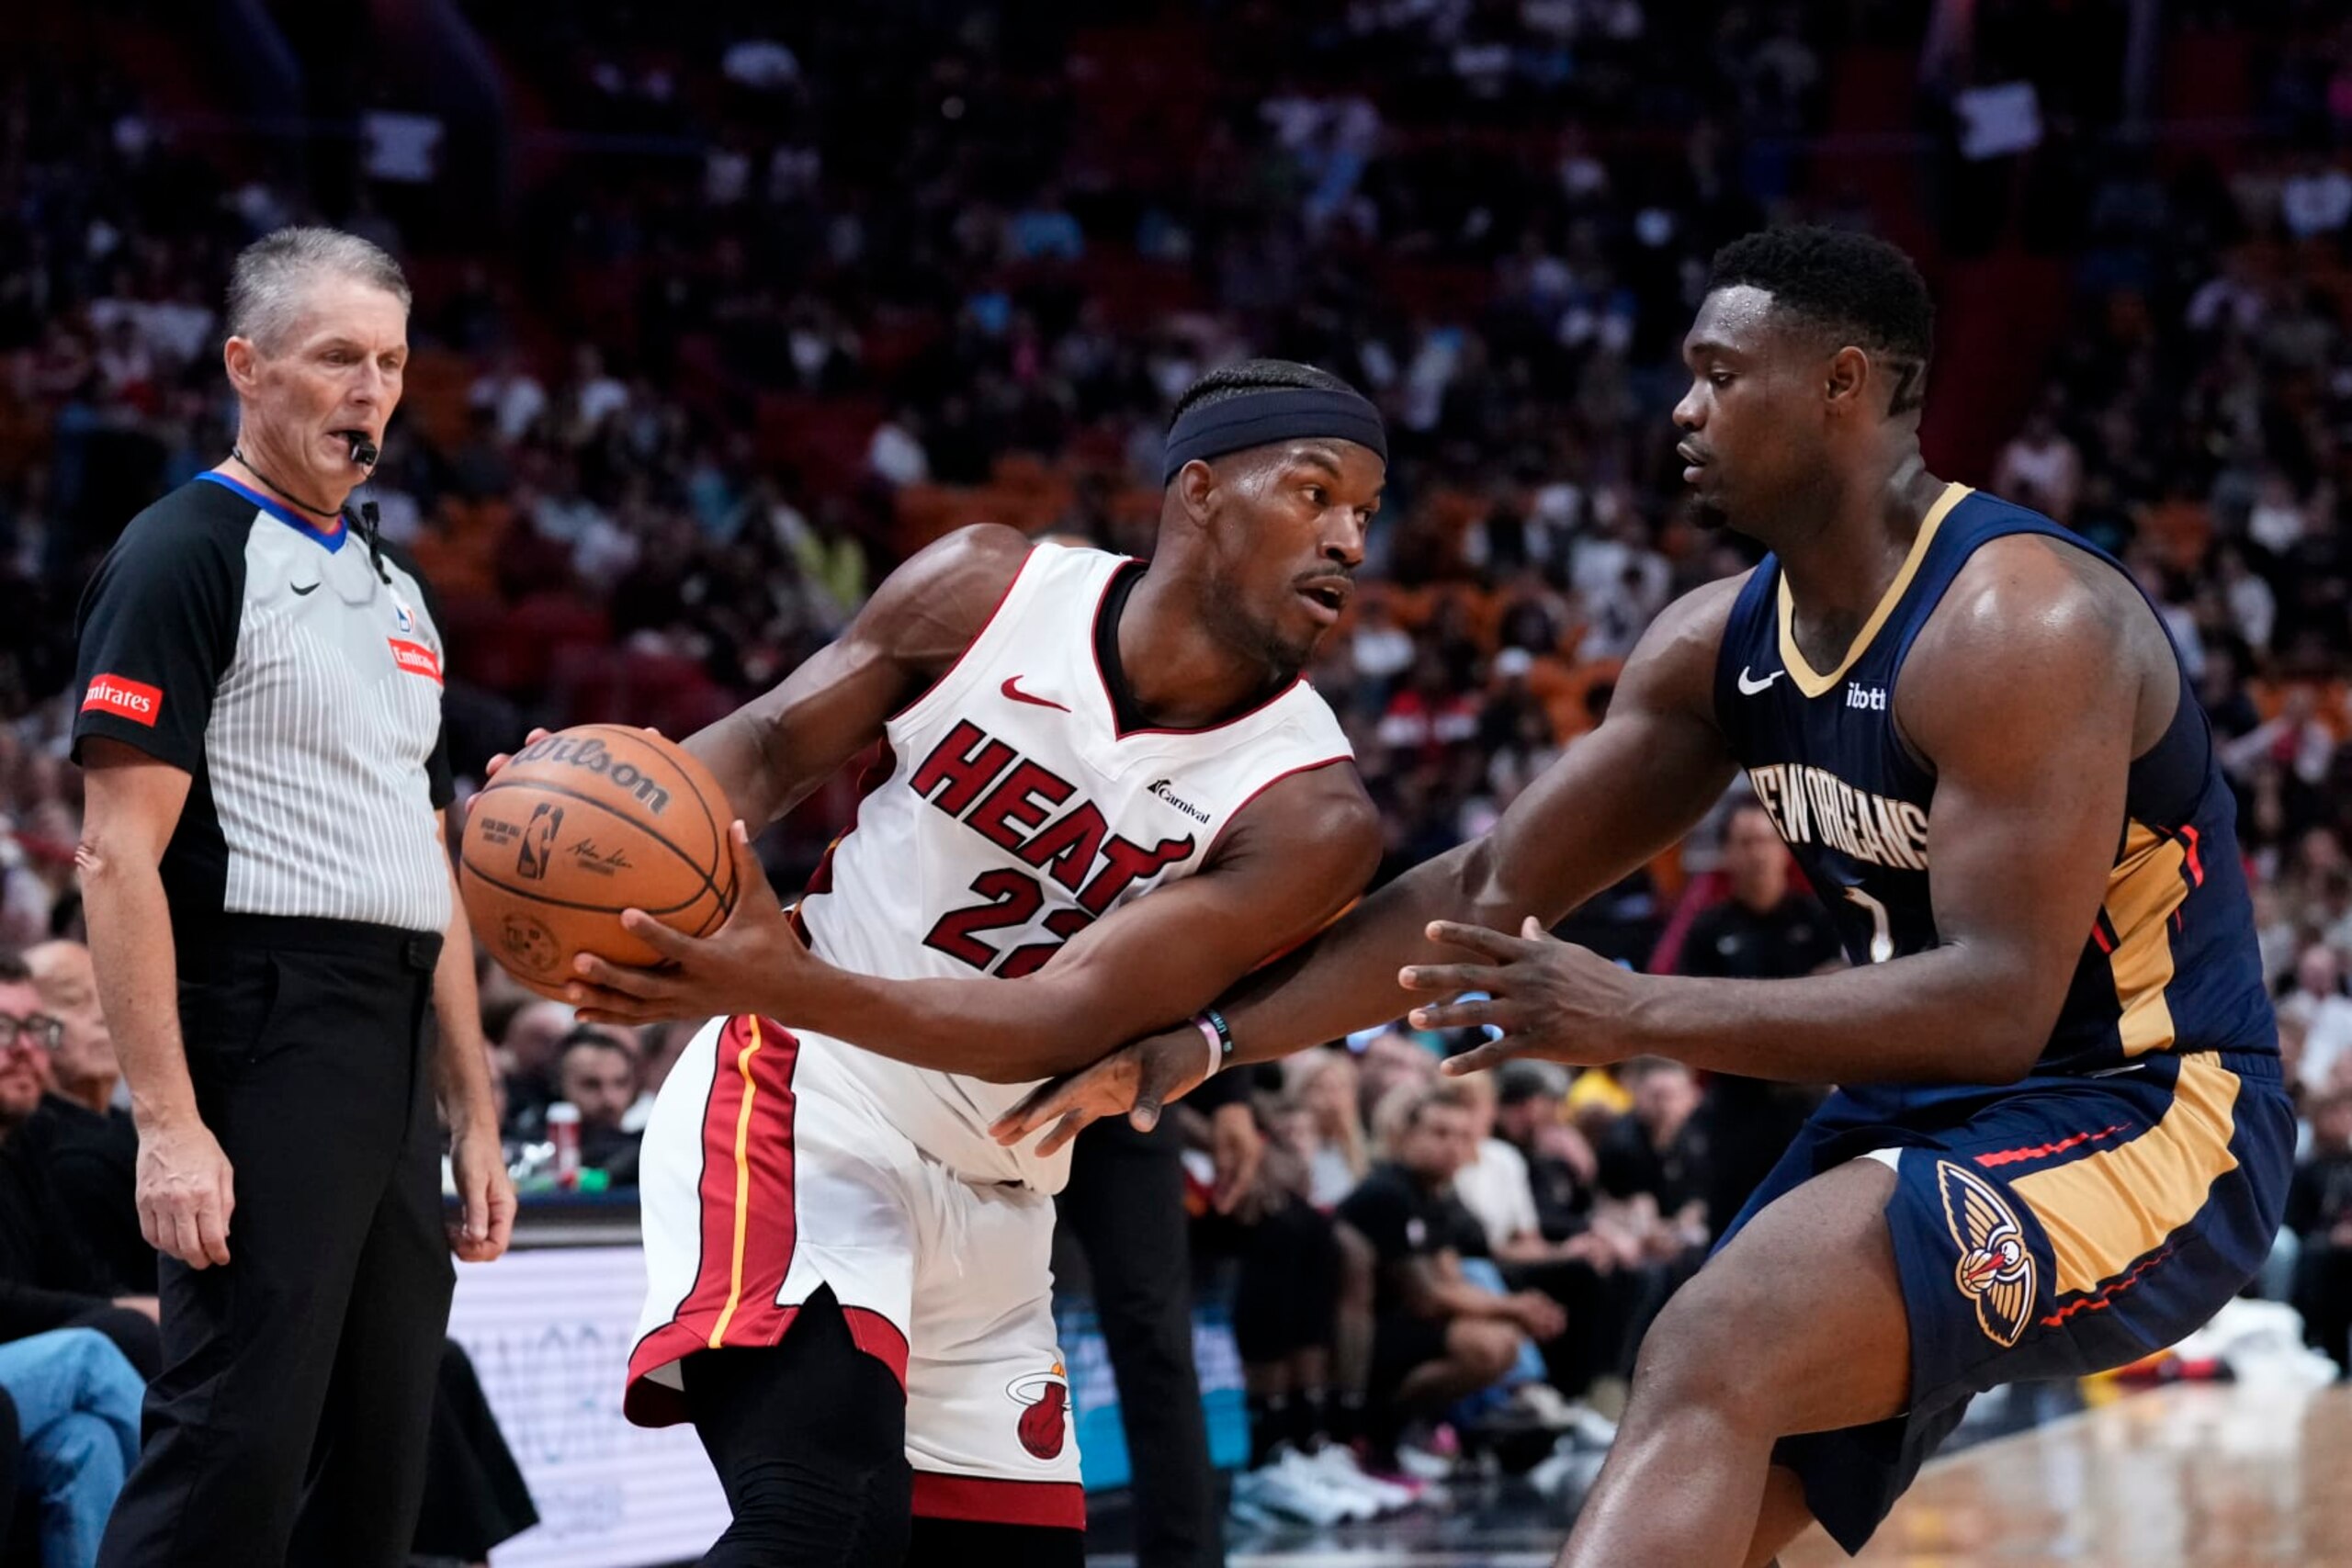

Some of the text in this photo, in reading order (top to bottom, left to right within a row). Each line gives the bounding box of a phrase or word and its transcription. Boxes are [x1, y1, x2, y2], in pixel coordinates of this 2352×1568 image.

[84, 681, 151, 714] mirates
[1845, 681, 1887, 711] ibott
[510, 735, 671, 817] Wilson
[1158, 787, 1211, 825] Carnival
[908, 717, 1196, 918] HEAT
[1804, 765, 1929, 871] ORLEANS
